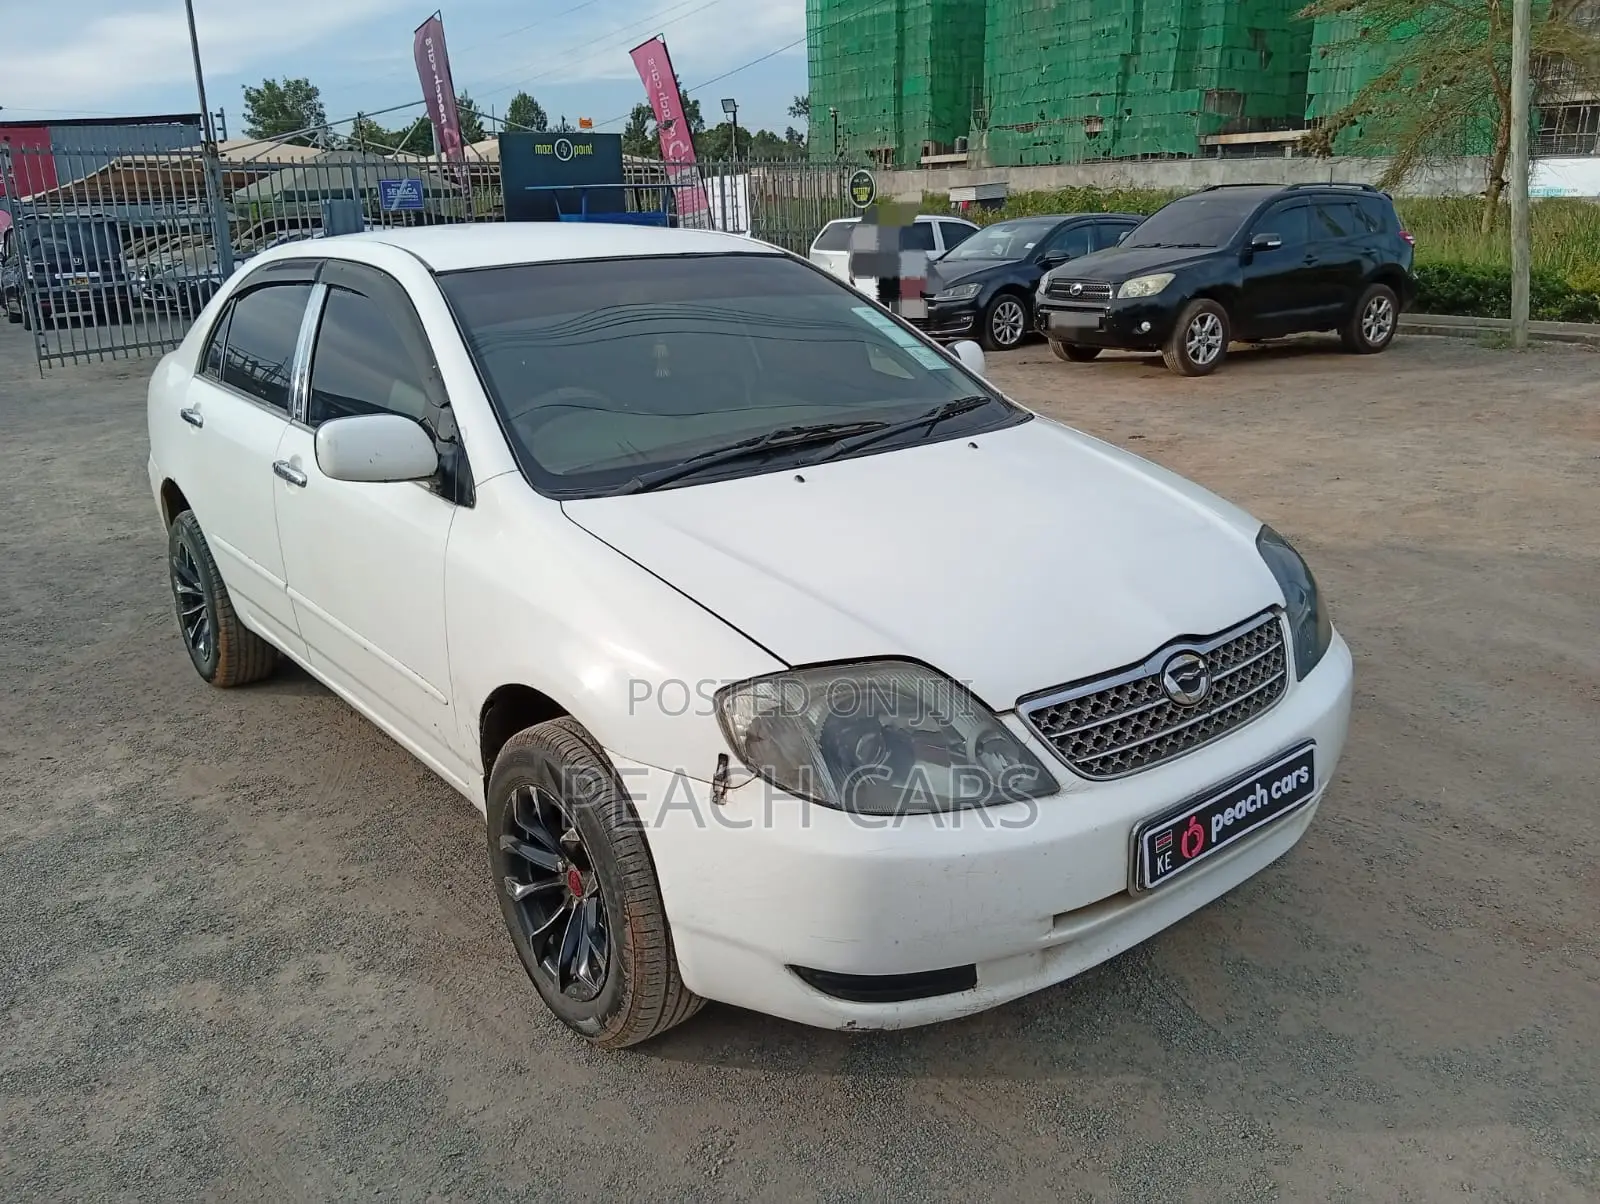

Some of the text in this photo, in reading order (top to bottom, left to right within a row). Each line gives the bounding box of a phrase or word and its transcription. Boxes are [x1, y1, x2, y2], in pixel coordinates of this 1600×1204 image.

[535, 143, 593, 158] mazi point
[1211, 765, 1309, 842] peach cars
[1156, 851, 1173, 875] KE
